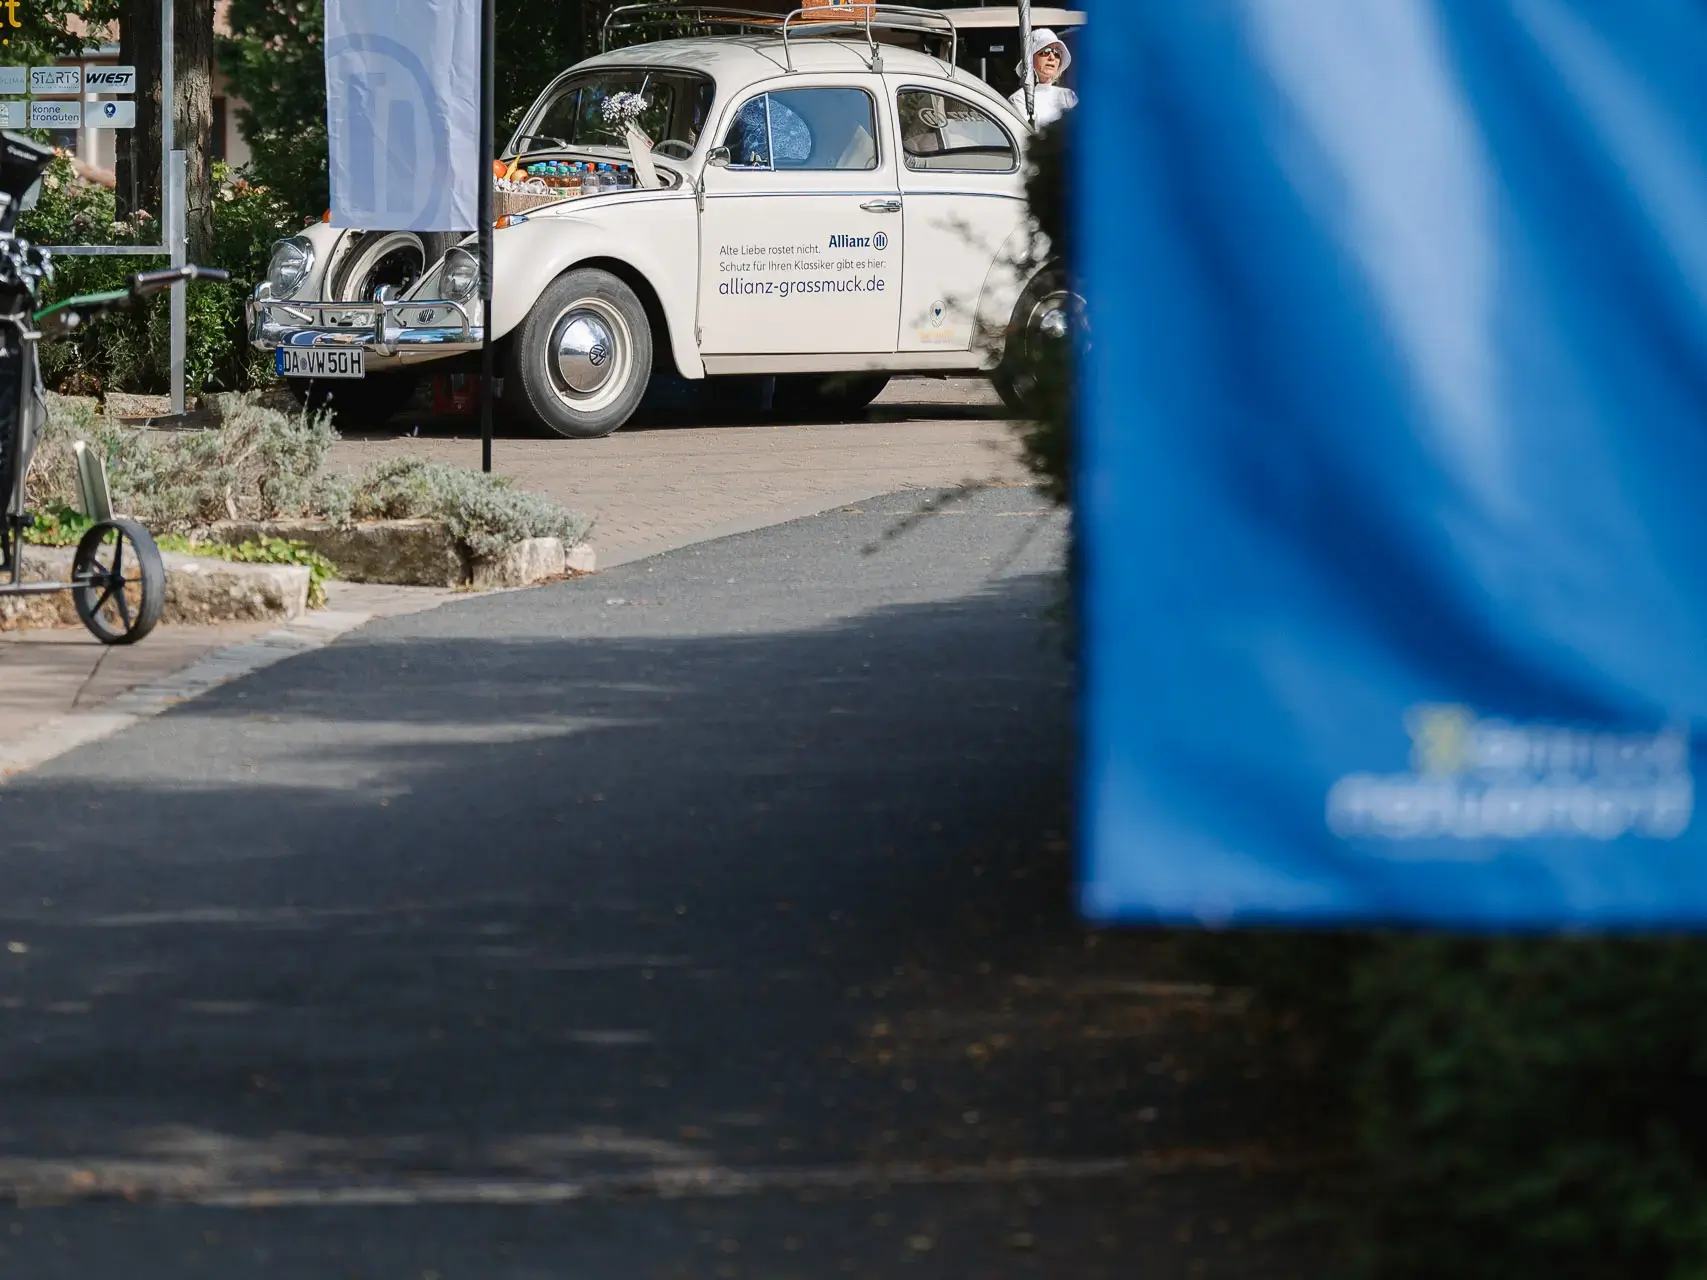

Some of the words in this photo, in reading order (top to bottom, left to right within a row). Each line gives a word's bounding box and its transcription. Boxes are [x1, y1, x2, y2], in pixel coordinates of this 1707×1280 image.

[86, 73, 133, 84] WIEST
[32, 105, 61, 113] konne
[32, 113, 79, 122] tronauten
[828, 234, 871, 248] Allianz
[719, 245, 739, 256] Alte
[741, 245, 766, 255] Liebe
[768, 245, 794, 255] rostet
[796, 244, 821, 254] nicht.
[719, 261, 751, 272] Schutz
[753, 261, 766, 271] für
[768, 261, 792, 271] Ihren
[794, 260, 834, 270] Klassiker
[836, 259, 854, 271] gibt
[856, 261, 866, 269] es
[867, 259, 887, 269] hier:
[718, 275, 885, 297] allianz-grassmuck.de
[284, 351, 299, 373] DA
[307, 352, 325, 373] VW
